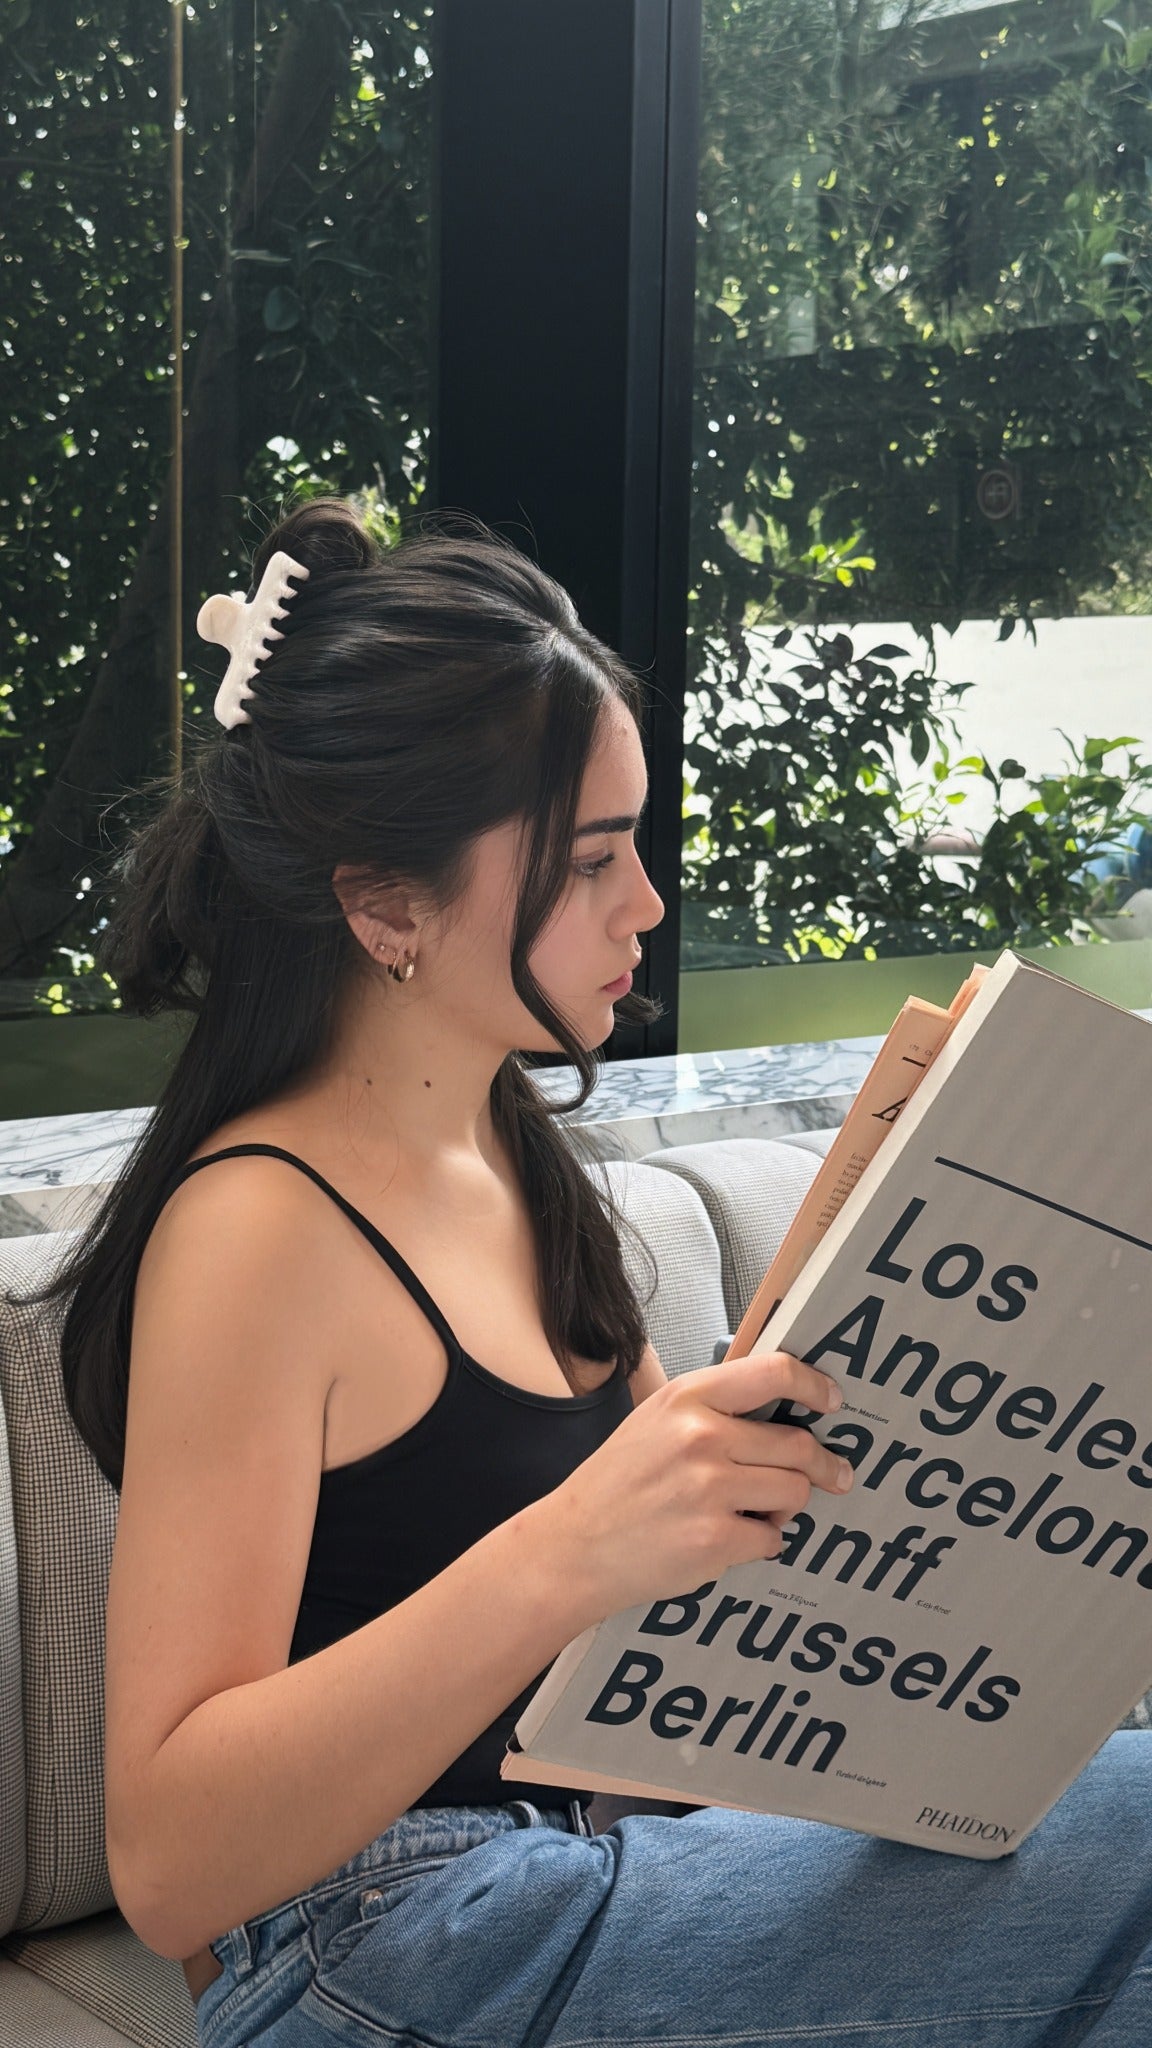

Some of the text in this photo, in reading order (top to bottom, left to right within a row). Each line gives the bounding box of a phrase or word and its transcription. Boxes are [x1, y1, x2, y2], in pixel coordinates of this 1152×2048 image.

[866, 1197, 1039, 1321] Los
[770, 1399, 1152, 1590] arcelon
[765, 1512, 958, 1601] anff
[585, 1650, 847, 1773] Berlin
[638, 1581, 1020, 1722] Brussels
[916, 1807, 1016, 1843] PHAIDON
